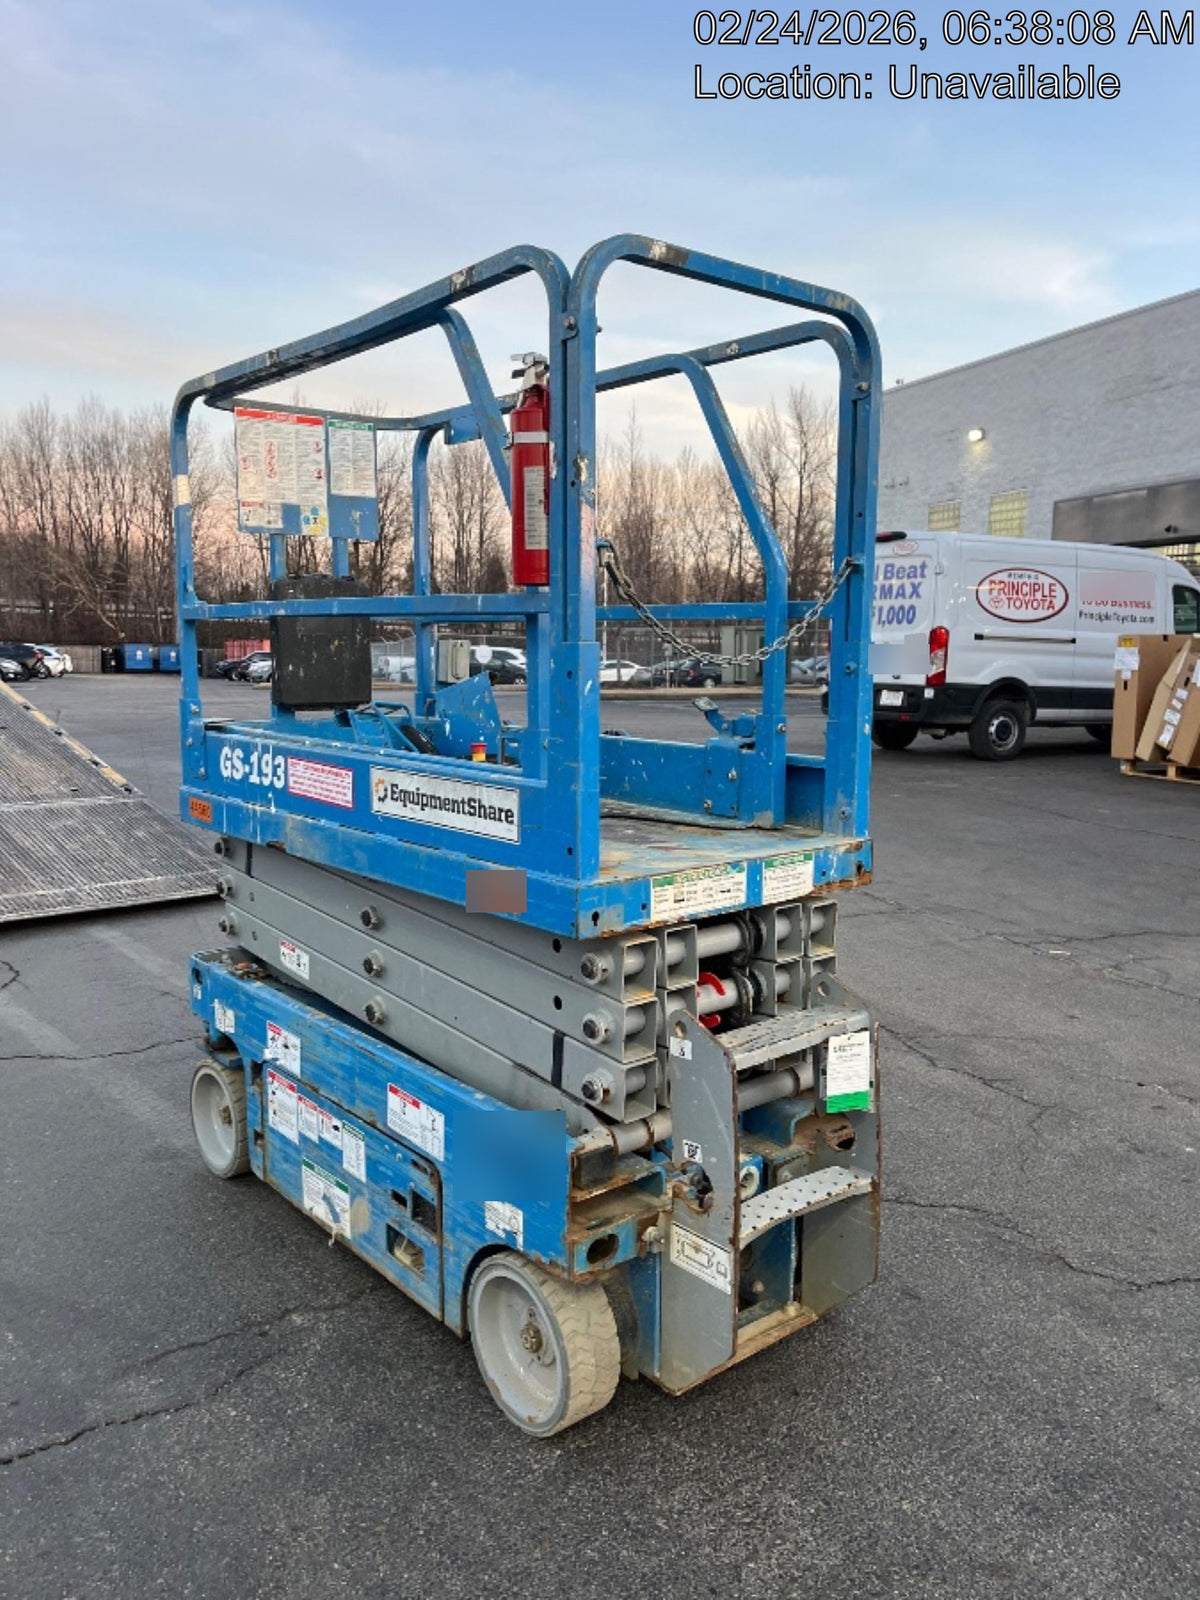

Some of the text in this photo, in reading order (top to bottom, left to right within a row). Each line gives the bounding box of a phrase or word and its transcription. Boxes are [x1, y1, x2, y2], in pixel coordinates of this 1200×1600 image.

[883, 560, 928, 581] Beat
[988, 580, 1057, 598] PRINCIPLE
[1006, 597, 1055, 611] TOYOTA
[220, 746, 285, 789] GS-193
[390, 783, 515, 825] EquipmentShare
